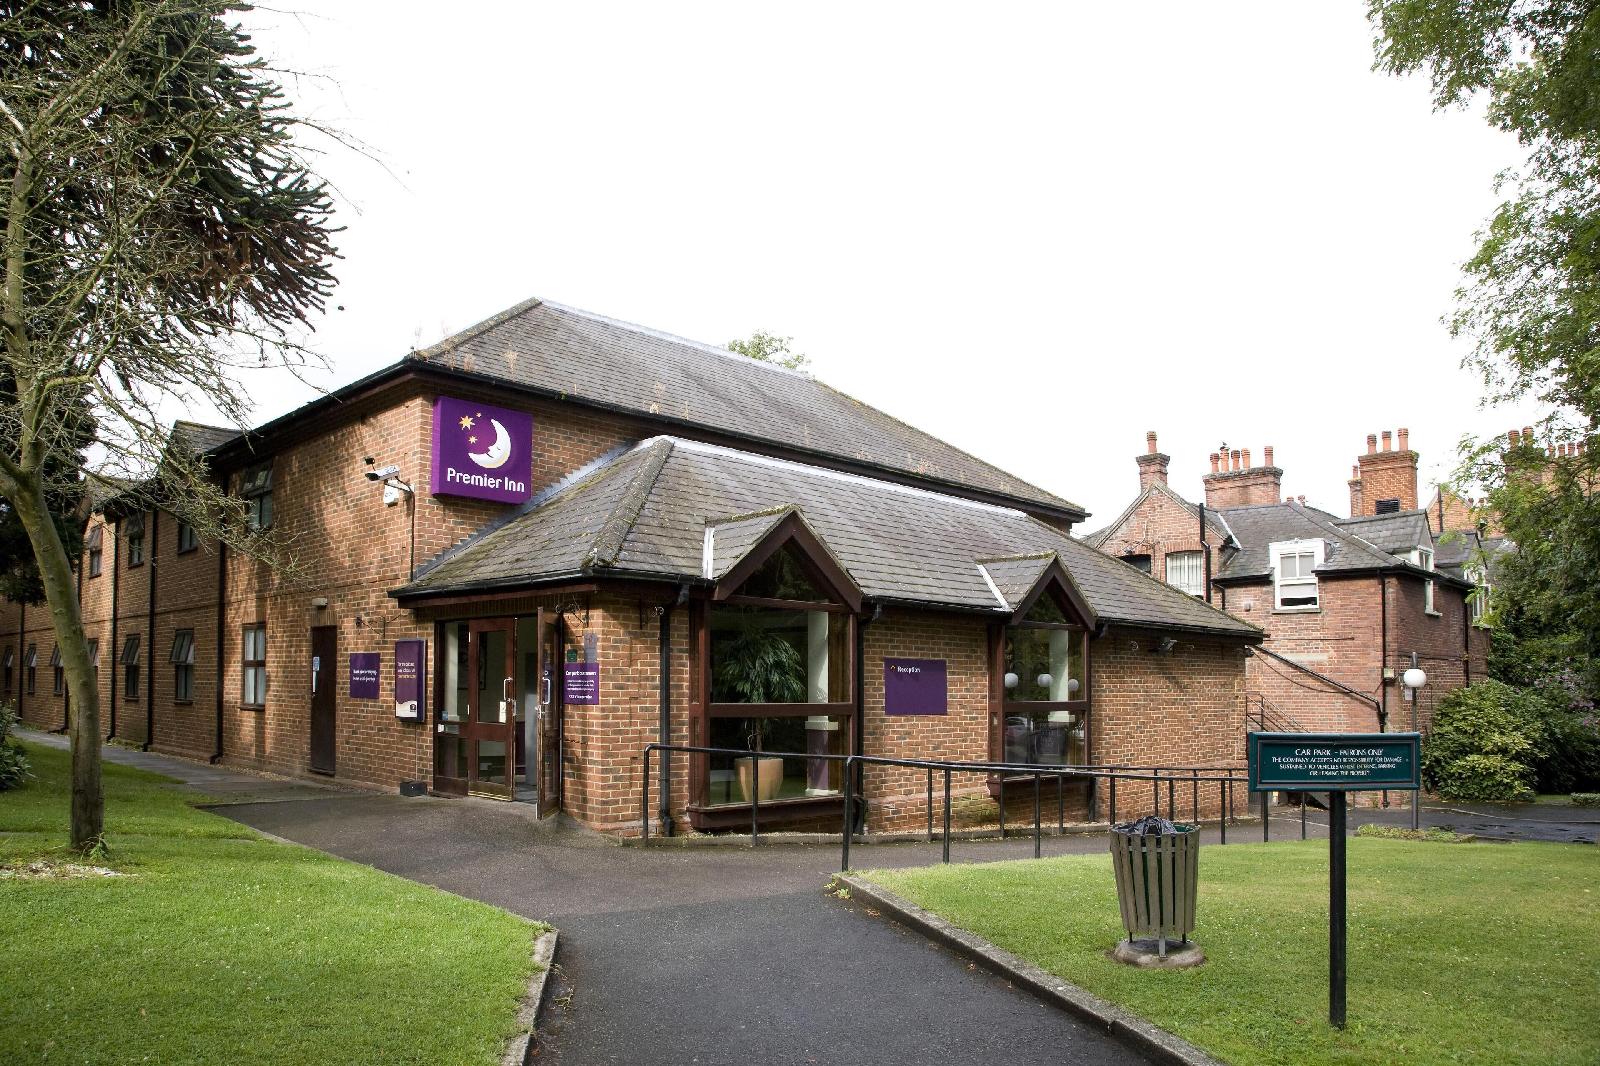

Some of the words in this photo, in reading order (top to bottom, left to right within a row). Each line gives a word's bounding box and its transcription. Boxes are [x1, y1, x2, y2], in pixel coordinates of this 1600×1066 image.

[446, 468, 502, 488] Premier
[504, 477, 524, 492] Inn
[898, 666, 920, 674] Reception
